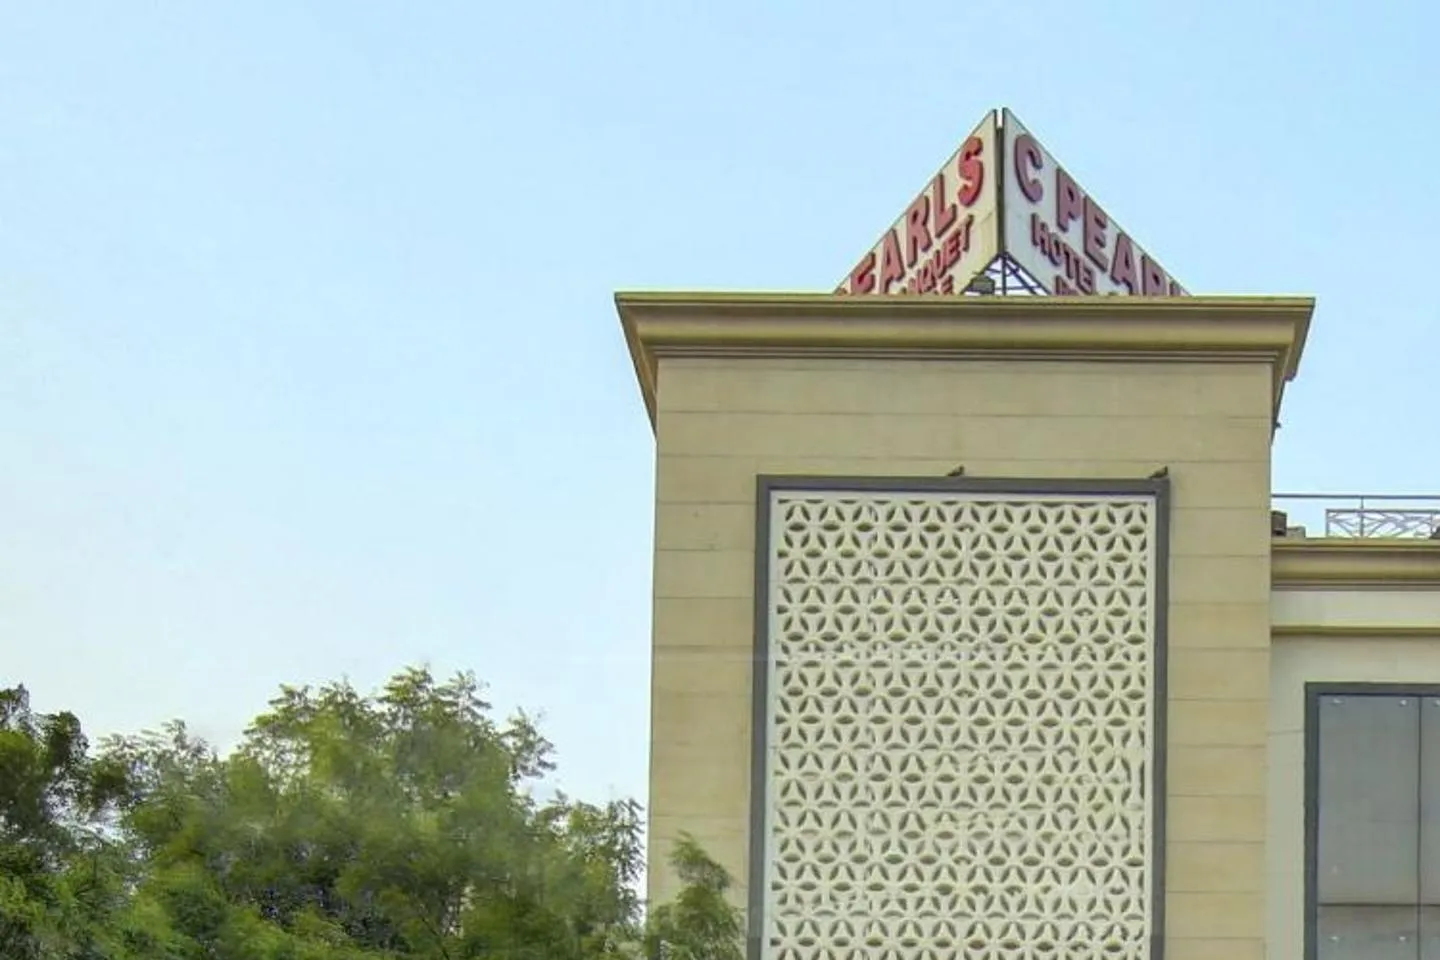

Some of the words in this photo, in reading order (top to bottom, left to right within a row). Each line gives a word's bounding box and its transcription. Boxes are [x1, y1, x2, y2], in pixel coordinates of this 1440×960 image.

[837, 136, 984, 294] EARLS
[1014, 134, 1043, 203] C
[1056, 167, 1182, 294] PEAR
